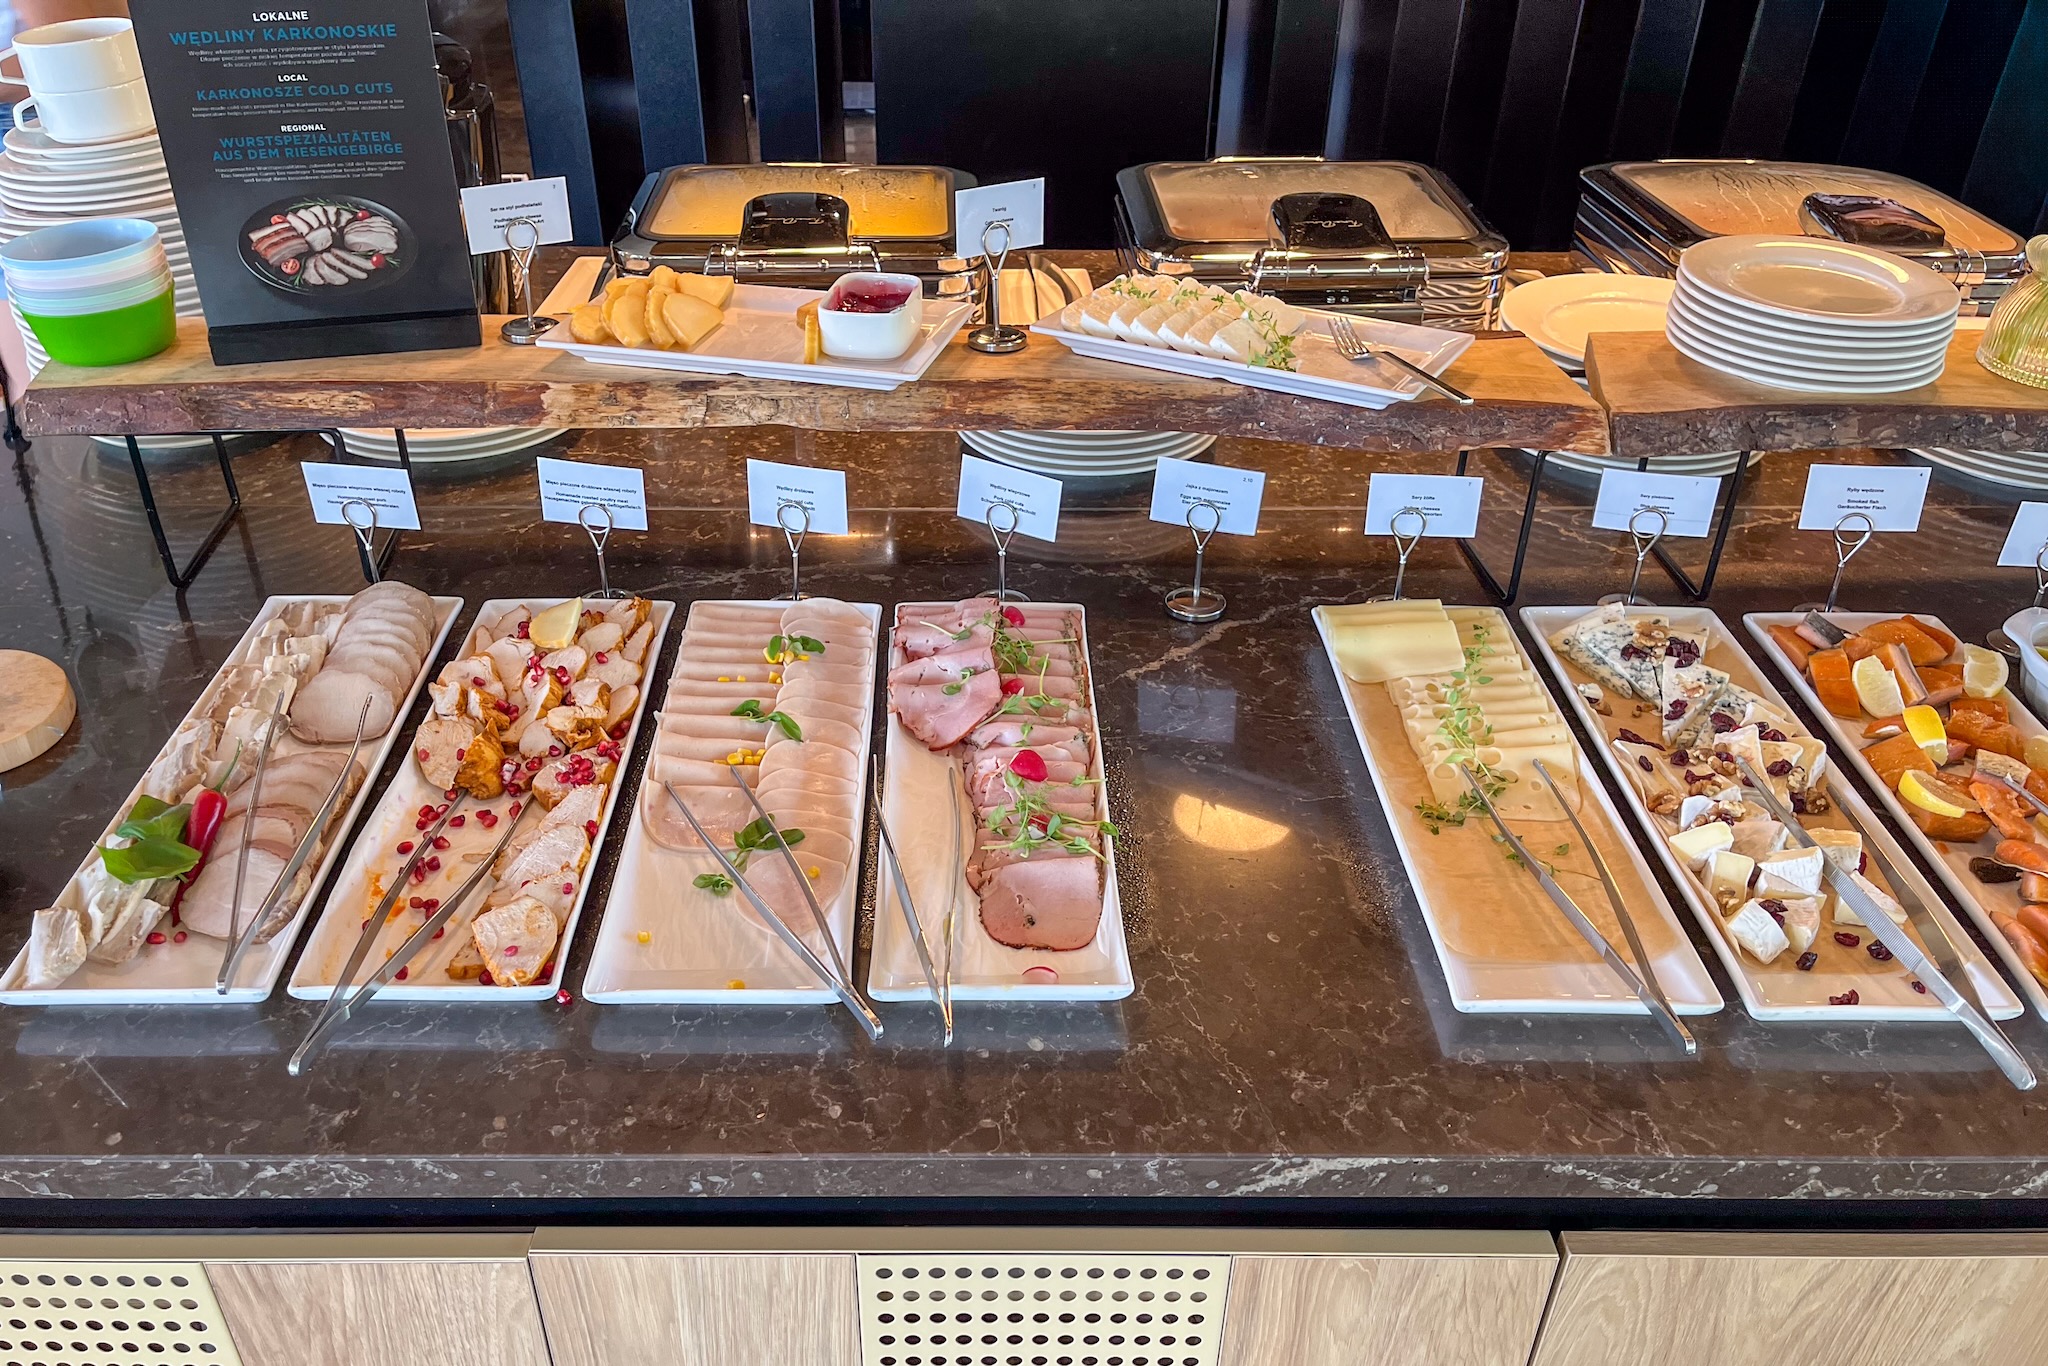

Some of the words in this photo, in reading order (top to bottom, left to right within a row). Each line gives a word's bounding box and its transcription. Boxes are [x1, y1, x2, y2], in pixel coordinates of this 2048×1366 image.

[252, 10, 309, 22] LOKALNE
[169, 29, 257, 47] WĘDLINY
[263, 23, 398, 42] KARKONOSKIE
[277, 73, 308, 83] LOCAL
[196, 86, 304, 101] KARKONOSZE
[308, 84, 350, 97] COLD
[354, 82, 393, 95] CUTS
[280, 123, 326, 133] REGIONAL
[219, 130, 391, 149] WURSTSPEZIALITÄTEN
[212, 150, 243, 161] AUS
[248, 148, 280, 160] DEM
[285, 143, 404, 158] RIESENGEBIRGE
